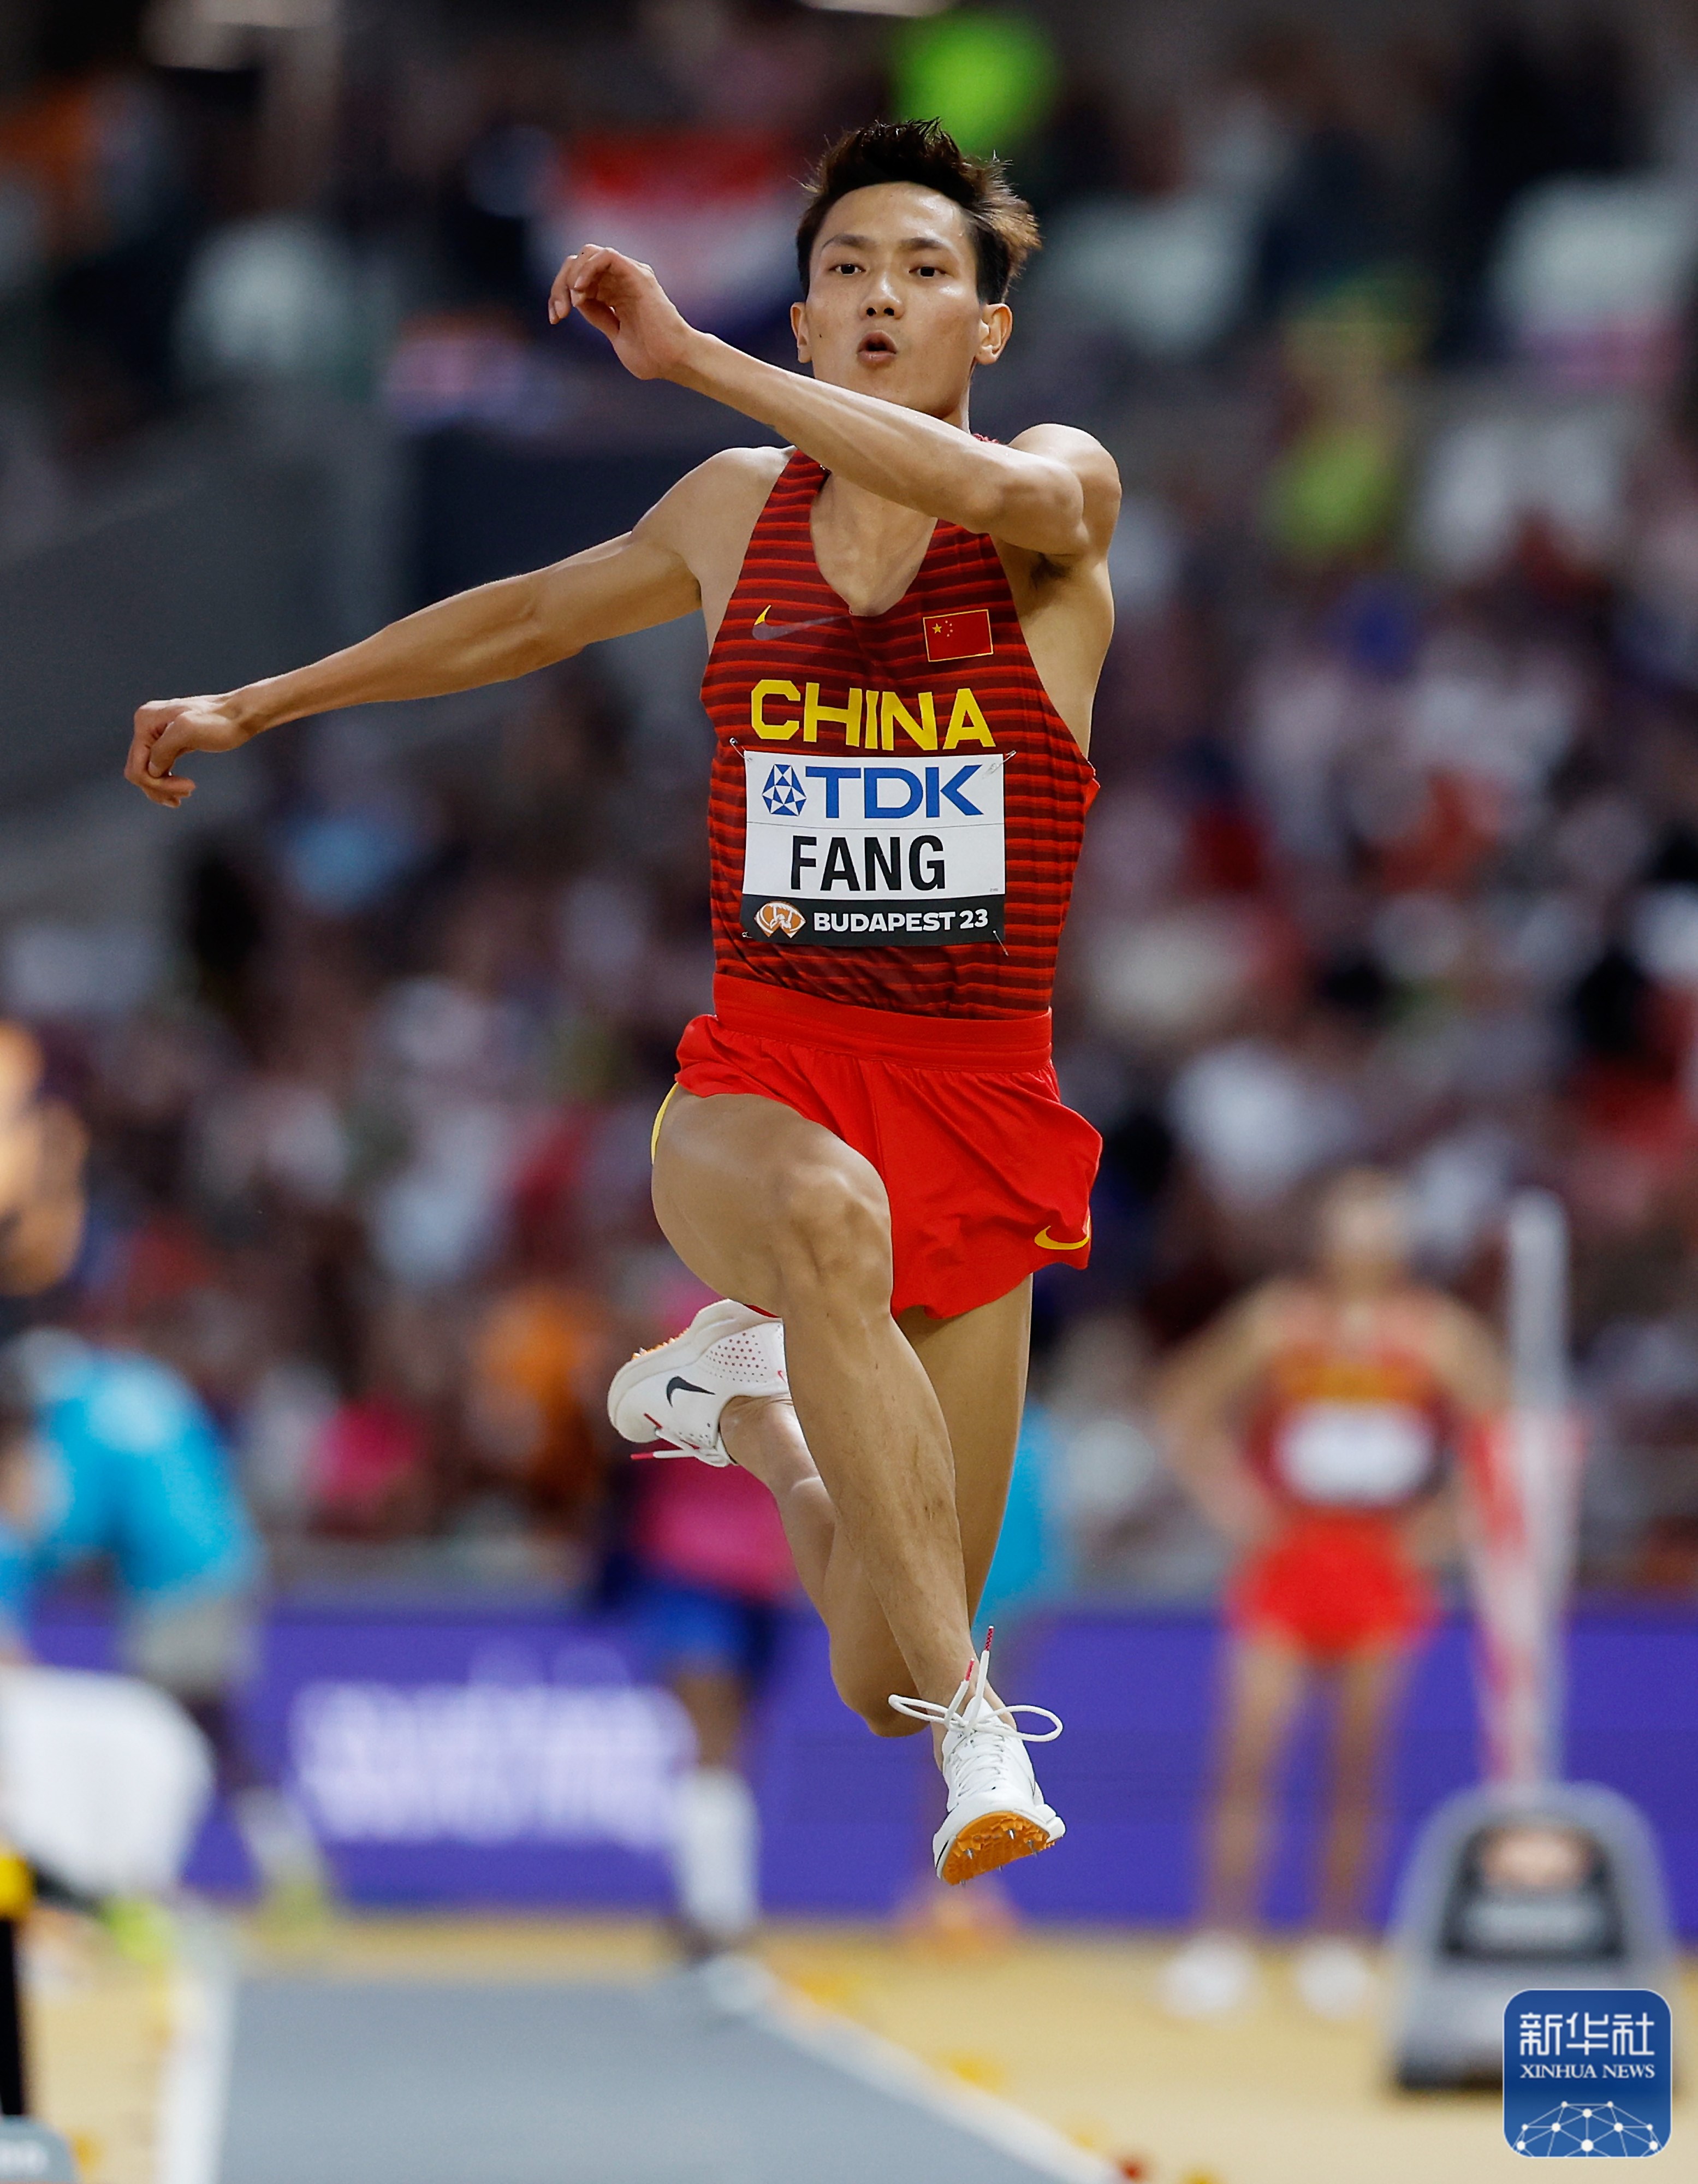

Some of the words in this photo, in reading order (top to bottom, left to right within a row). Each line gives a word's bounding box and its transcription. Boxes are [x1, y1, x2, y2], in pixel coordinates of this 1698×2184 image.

[751, 680, 995, 750] CHINA
[805, 764, 983, 819] TDK
[791, 835, 945, 891] FANG
[814, 911, 955, 932] BUDAPEST
[960, 909, 988, 929] 23
